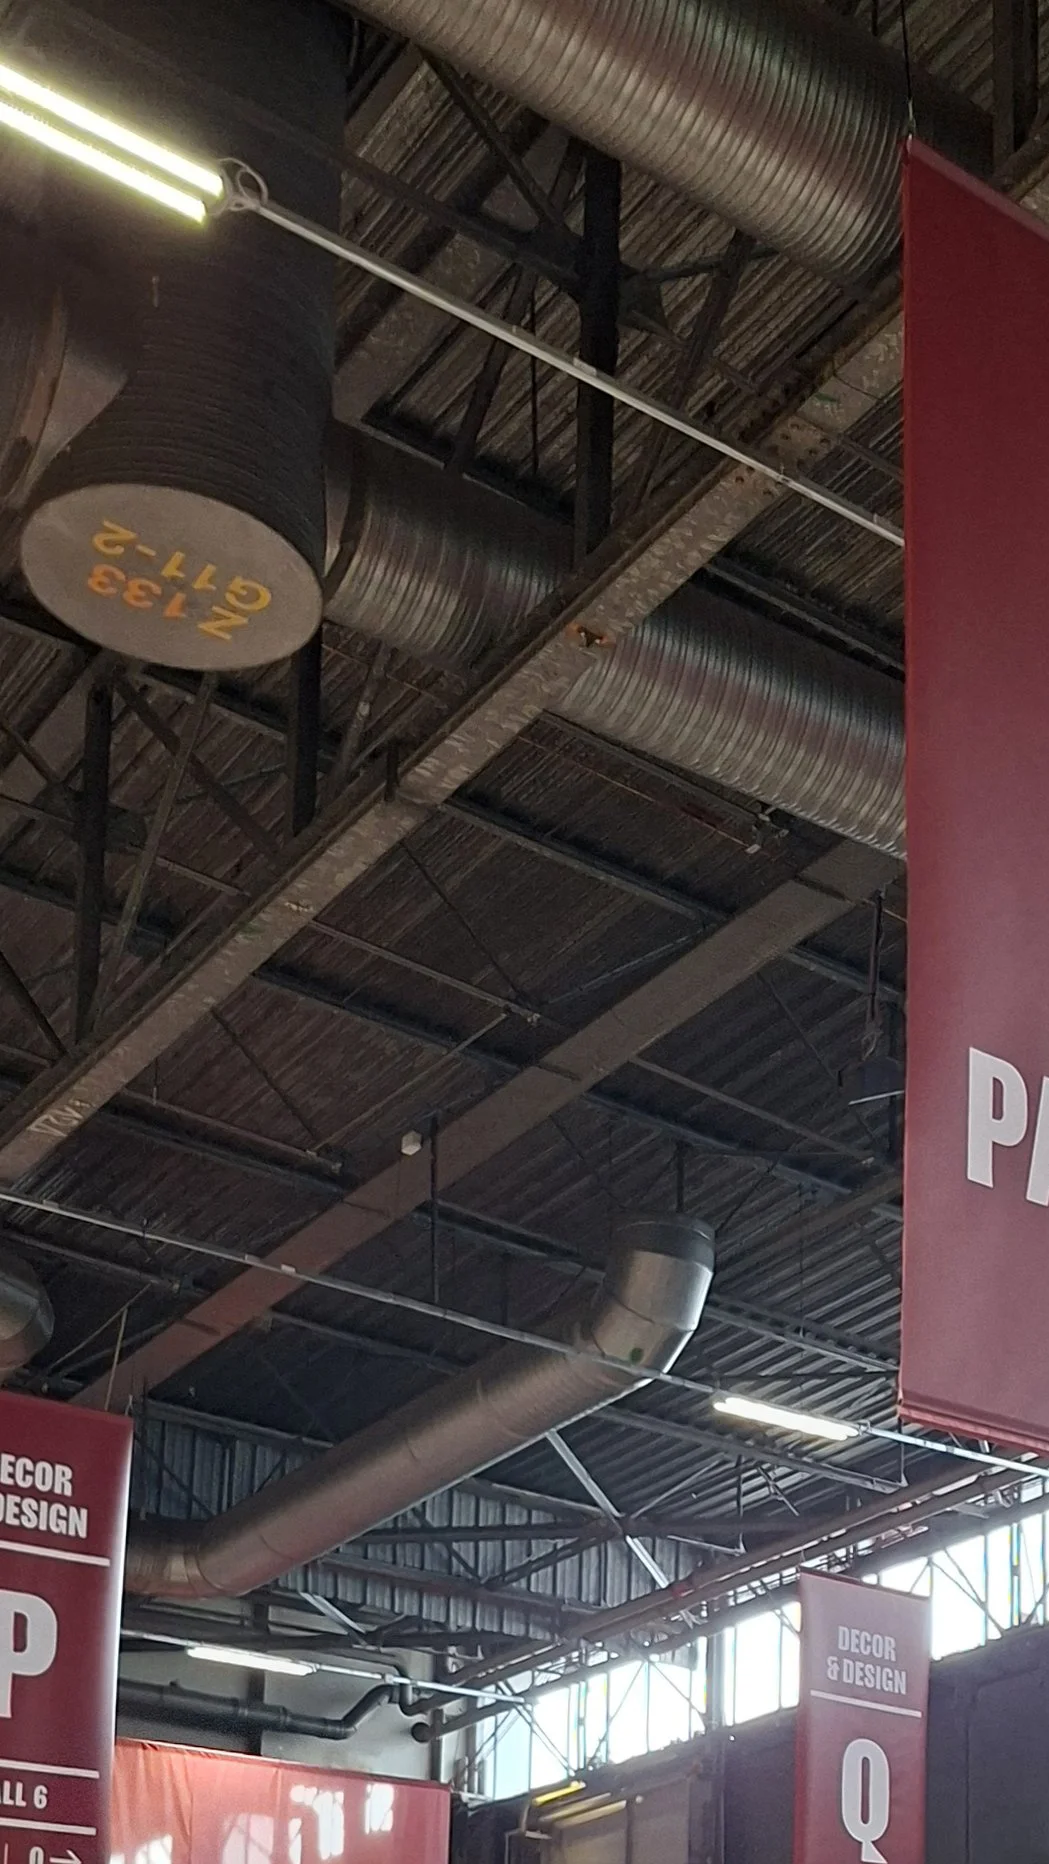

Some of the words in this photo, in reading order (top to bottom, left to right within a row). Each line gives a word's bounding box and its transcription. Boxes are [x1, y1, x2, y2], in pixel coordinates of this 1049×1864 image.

[91, 519, 272, 612] G11-2
[87, 563, 188, 620] 133
[0, 1453, 73, 1498] ECOR
[0, 1588, 58, 1718] P
[837, 1625, 897, 1662] DECOR
[826, 1655, 841, 1681] &
[842, 1657, 907, 1696] DESIGN
[0, 1779, 27, 1808] LL
[33, 1784, 48, 1810] 6
[840, 1737, 891, 1864] Q
